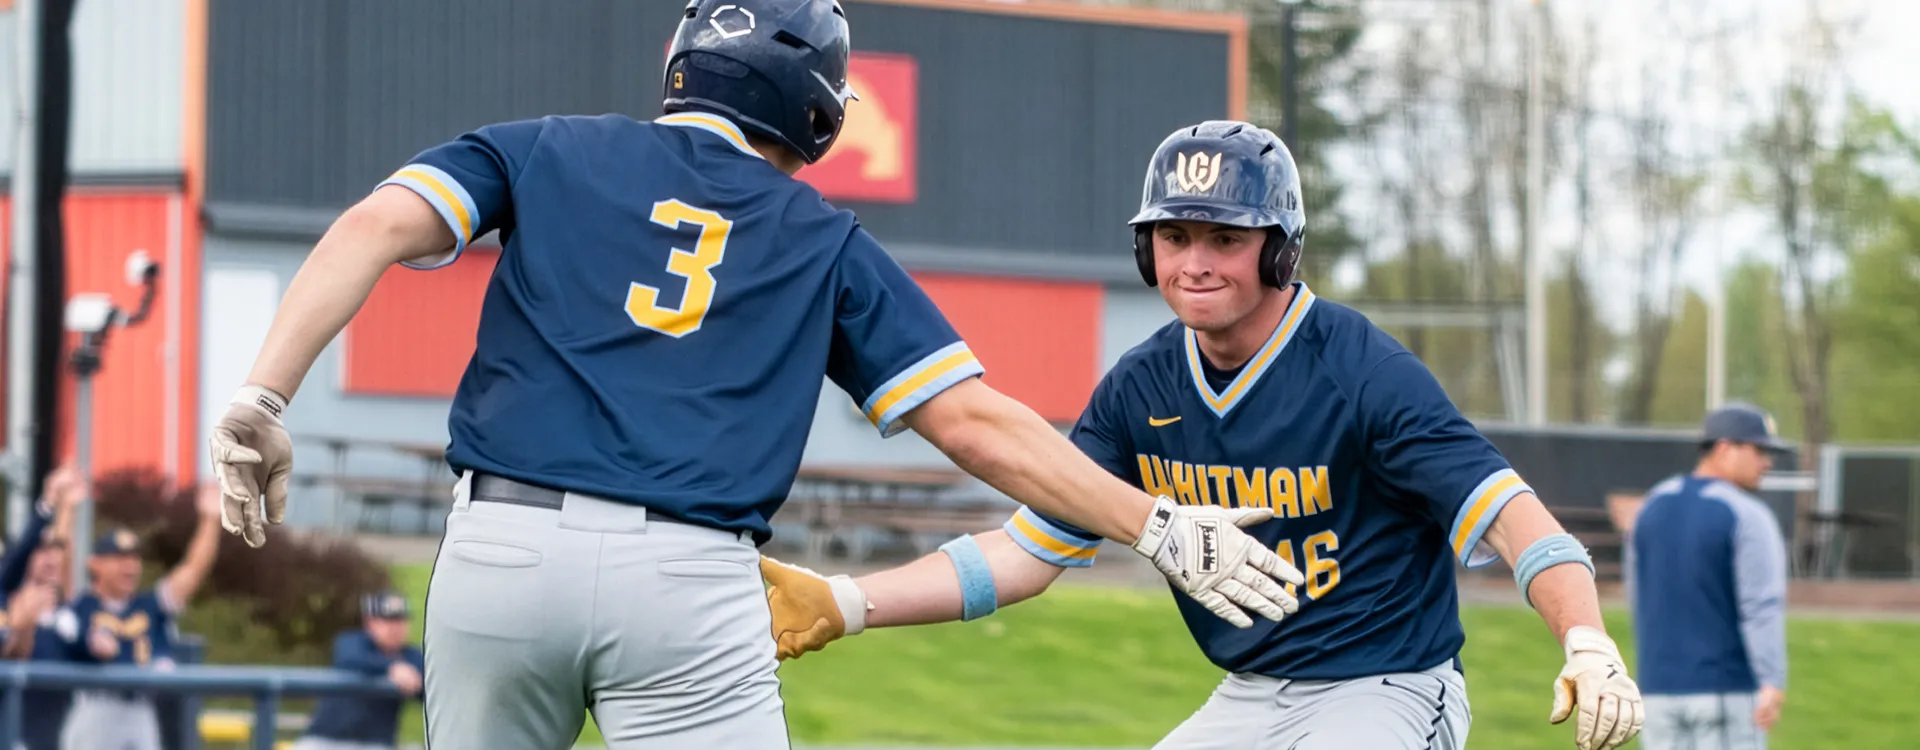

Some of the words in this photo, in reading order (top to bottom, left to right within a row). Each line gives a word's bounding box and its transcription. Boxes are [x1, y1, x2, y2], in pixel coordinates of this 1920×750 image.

[674, 71, 684, 89] 3
[624, 198, 734, 339] 3
[1136, 453, 1333, 518] WHITMAN
